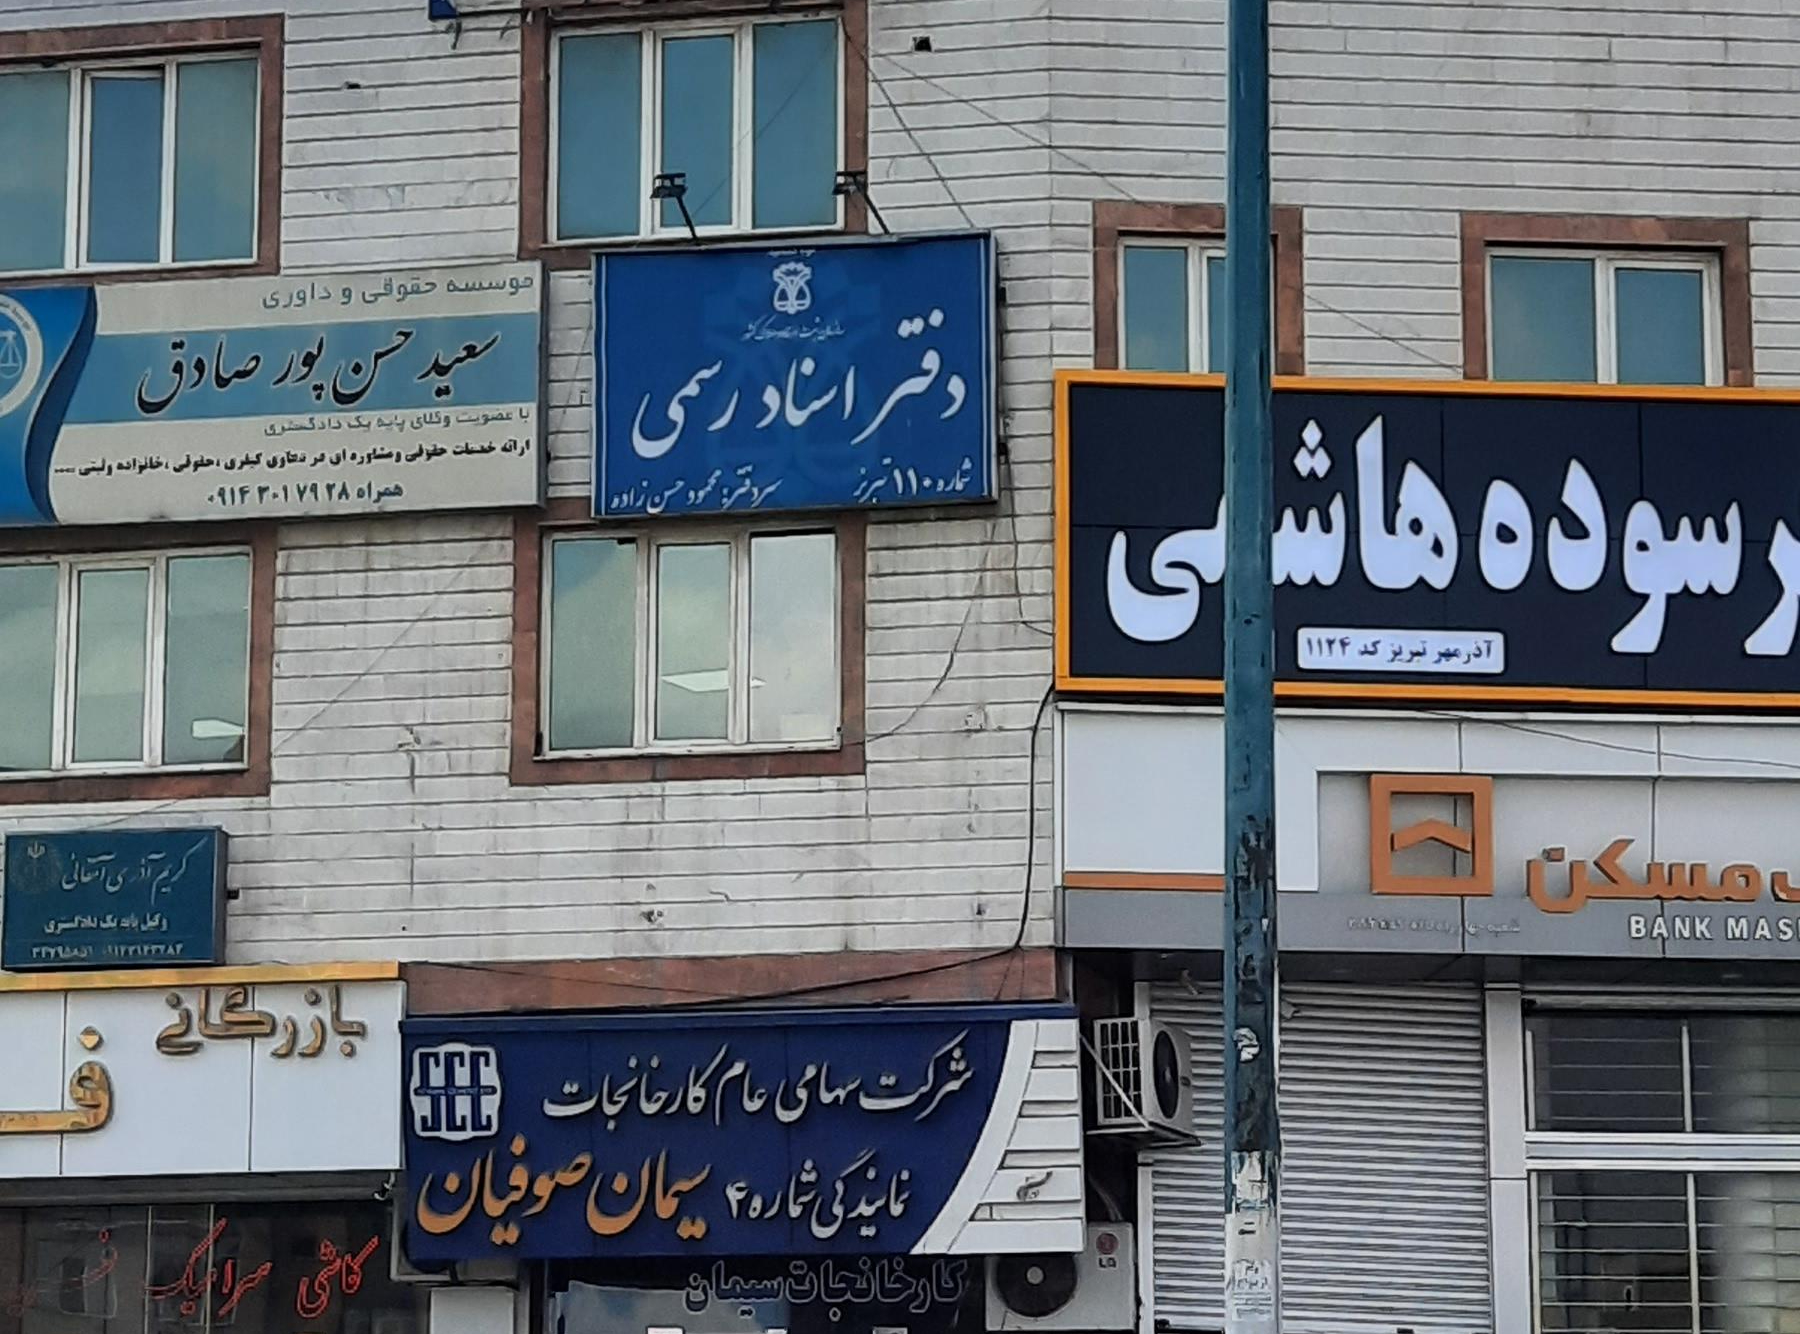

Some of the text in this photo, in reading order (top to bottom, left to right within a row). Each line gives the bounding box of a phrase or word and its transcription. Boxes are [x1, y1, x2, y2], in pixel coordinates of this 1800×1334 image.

[262, 281, 332, 309] داوری
[340, 286, 354, 306] و
[361, 276, 438, 304] حقوقی
[134, 326, 500, 415] سعید حسن پور صادق
[630, 307, 967, 460] دفتر اسناد رسمی
[517, 407, 531, 424] با
[356, 480, 404, 504] همراه
[610, 479, 649, 509] زاده
[646, 479, 686, 514] حسن
[852, 456, 893, 504] تبریز
[935, 456, 973, 493] شماره
[1106, 414, 1460, 643] هاشی
[1478, 457, 1744, 655] سوده
[1305, 635, 1352, 659] ۱۱۲۴
[1358, 638, 1382, 657] کد
[1386, 639, 1428, 664] تبریز
[151, 836, 209, 907] کریم
[1526, 837, 1762, 914] مسکن
[1628, 915, 1800, 942] BANK MAS
[155, 984, 368, 1059] بازرگانی
[542, 1028, 976, 1131] شرکت سهامی عام کارخانجات
[415, 1132, 712, 1247] سیمان صوفیان
[725, 1147, 912, 1240] نمایندگی شماره ۴
[296, 1233, 381, 1320] کاشی
[682, 1255, 969, 1323] کارخانجات سیمان
